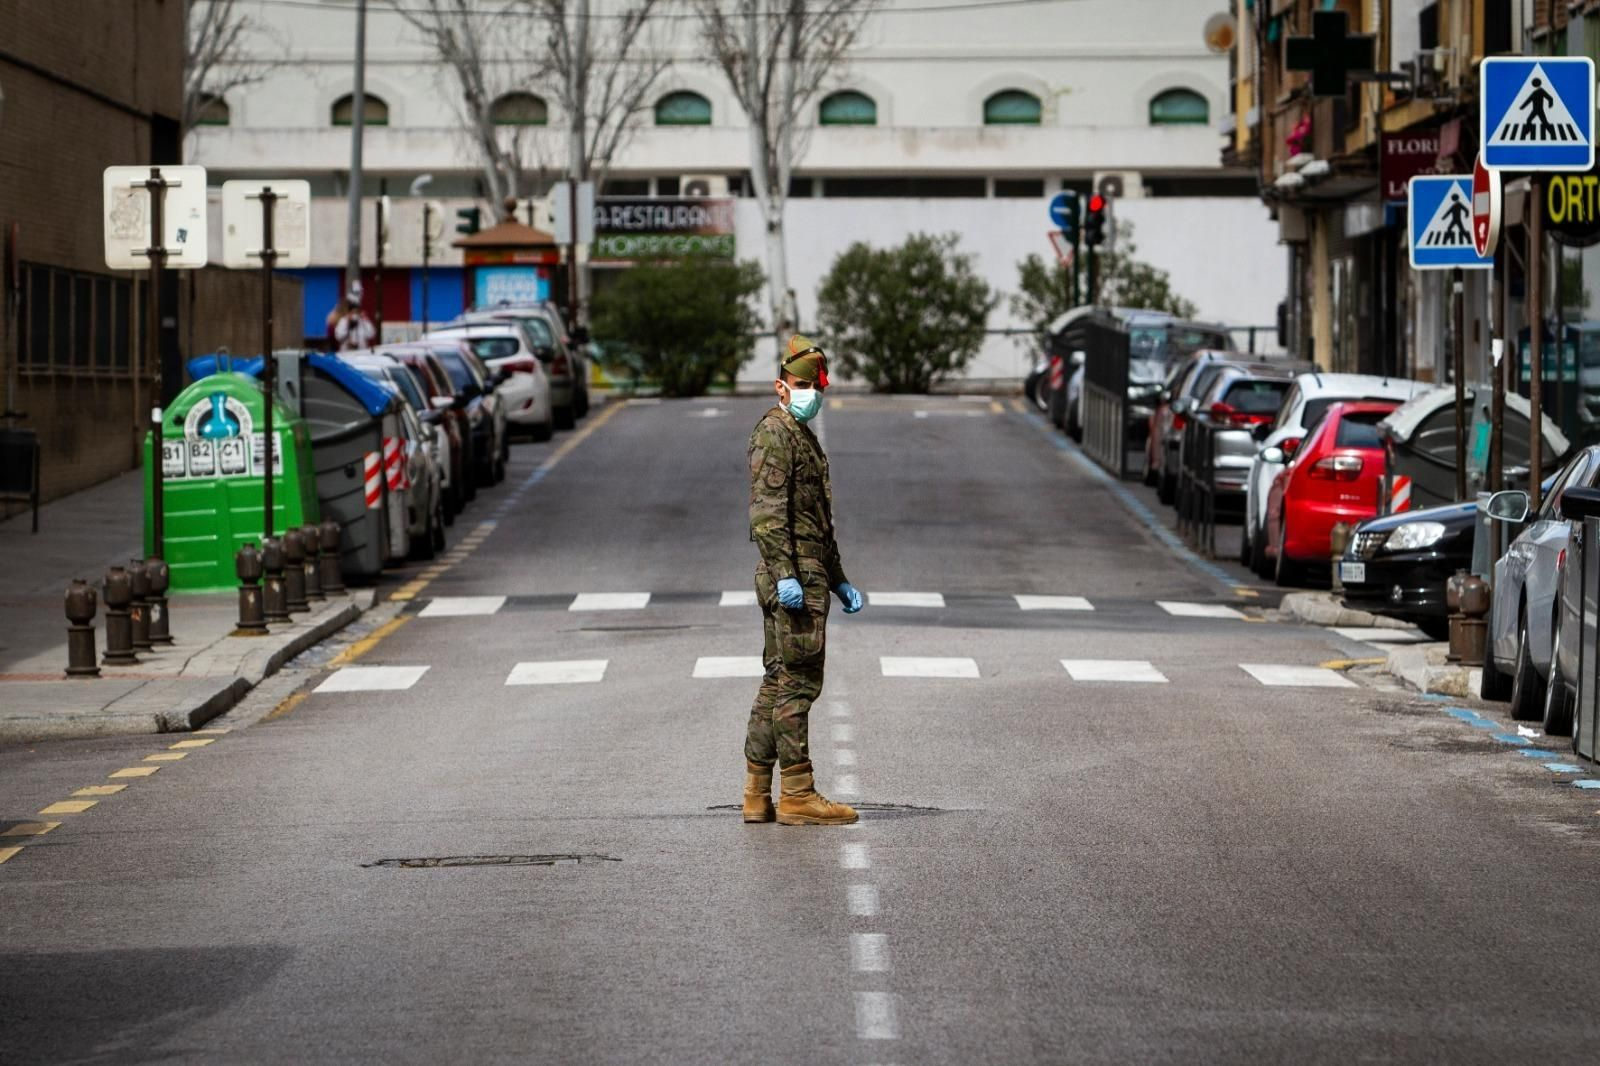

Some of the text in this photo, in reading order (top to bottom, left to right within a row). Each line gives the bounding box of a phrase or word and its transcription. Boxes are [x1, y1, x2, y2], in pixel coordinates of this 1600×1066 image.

[1387, 138, 1441, 155] FLORI
[1548, 174, 1600, 223] ORT
[191, 443, 210, 457] B2
[222, 442, 240, 456] C1
